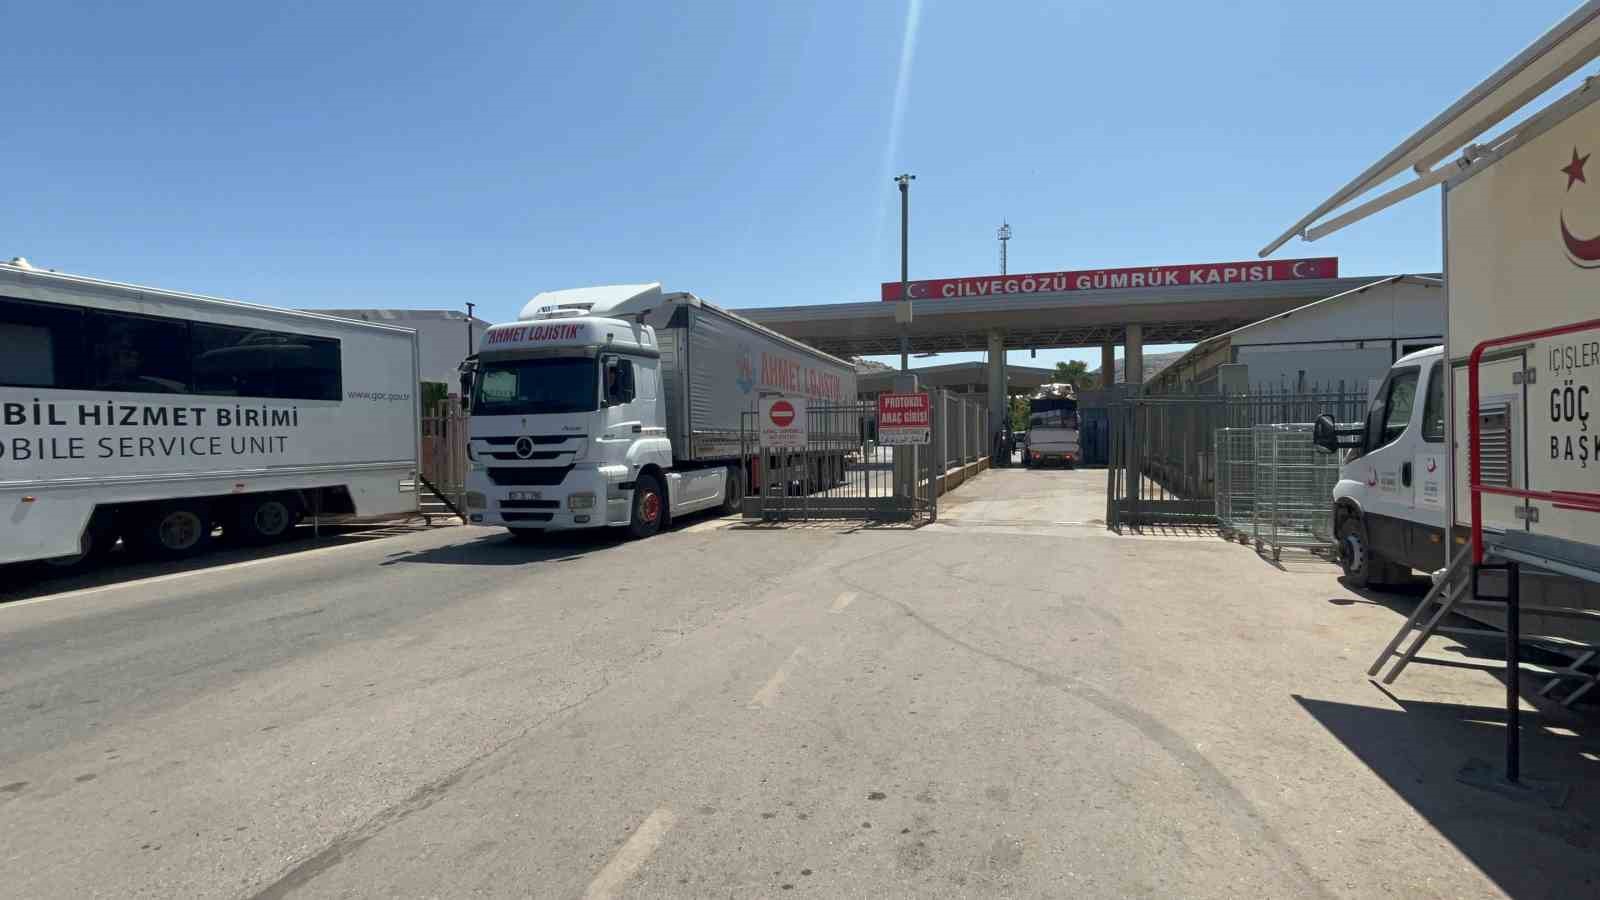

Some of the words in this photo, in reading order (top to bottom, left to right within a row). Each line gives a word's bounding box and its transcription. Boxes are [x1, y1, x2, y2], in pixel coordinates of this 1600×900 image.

[1077, 268, 1179, 289] GÜMRÜK
[1190, 265, 1273, 284] KAPISI
[79, 400, 206, 426] HİZMET
[217, 404, 298, 427] BİRİMİ
[885, 396, 923, 408] PROTOKOL
[1551, 379, 1589, 431] GÖÇ
[0, 437, 85, 460] BILE
[98, 437, 223, 458] SERVICE
[231, 436, 288, 454] UNIT
